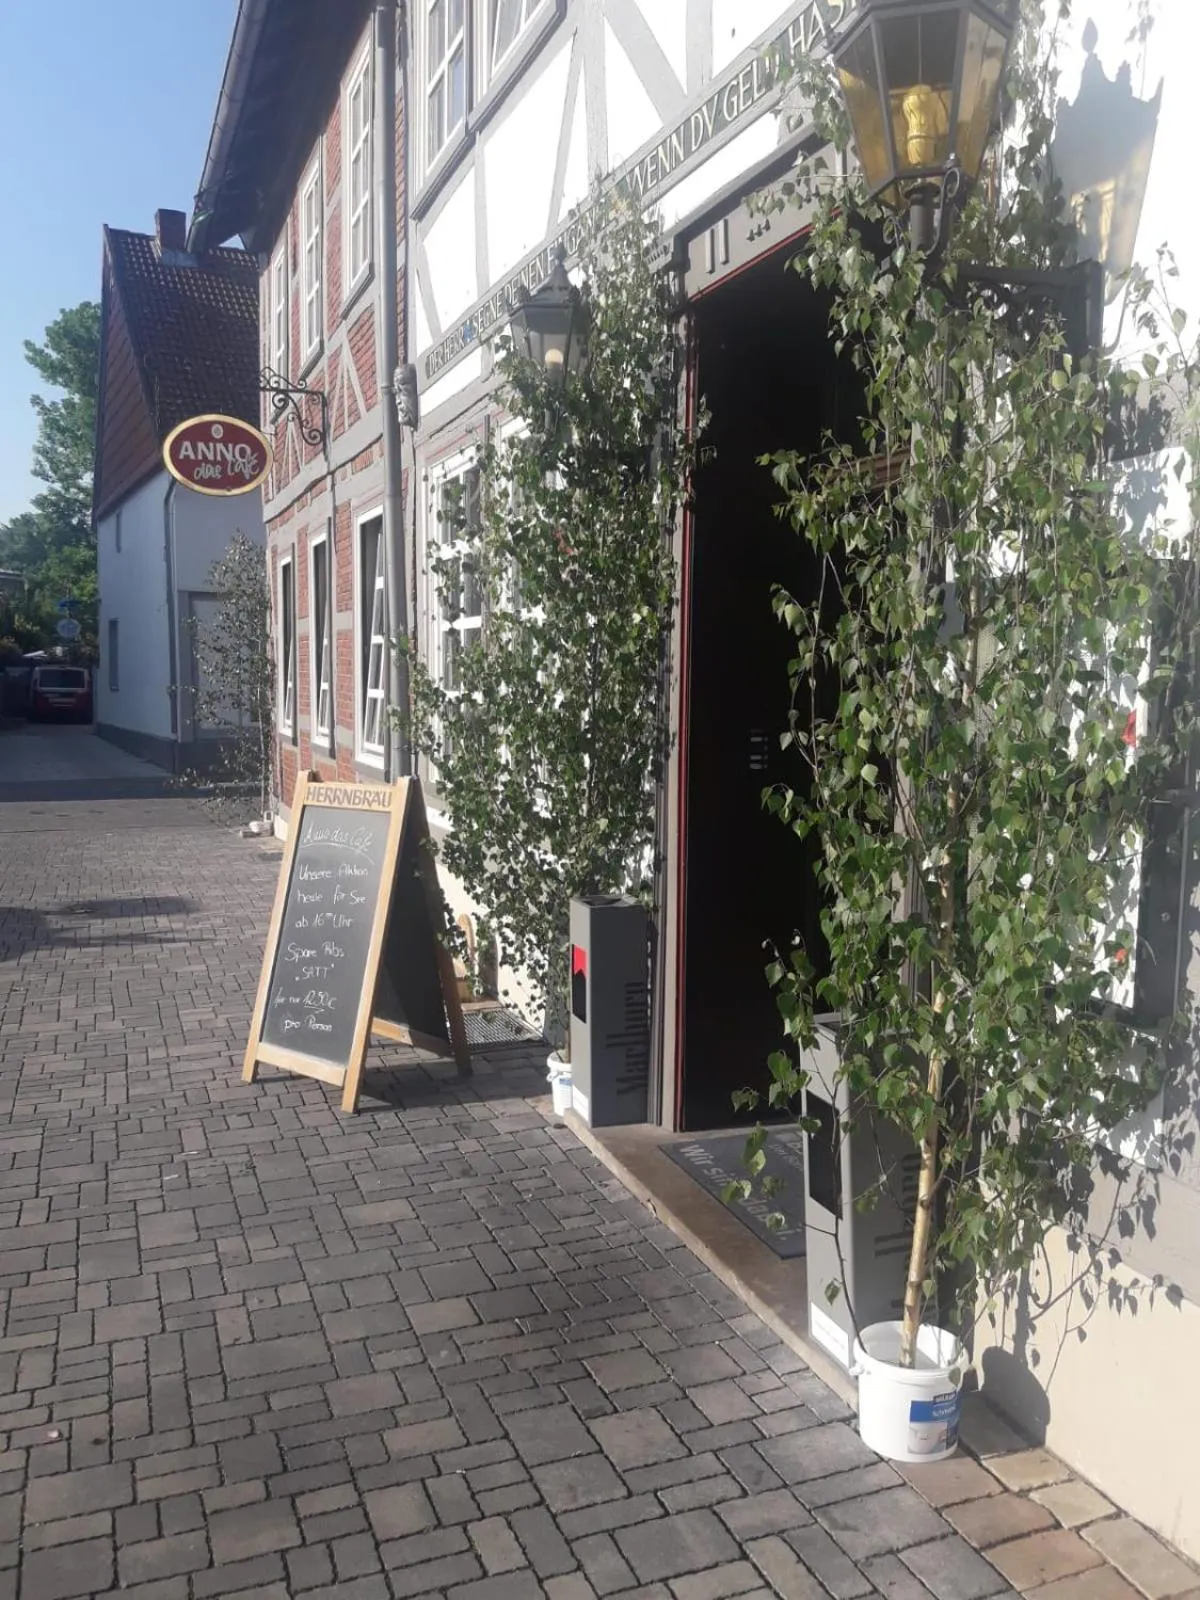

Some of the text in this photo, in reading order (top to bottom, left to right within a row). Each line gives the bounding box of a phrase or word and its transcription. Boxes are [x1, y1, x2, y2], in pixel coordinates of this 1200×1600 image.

[471, 290, 503, 338] SEGNE
[626, 124, 685, 196] WENN
[690, 93, 720, 152] DV
[788, 0, 857, 67] HAS
[179, 441, 251, 461] ANNO
[193, 462, 221, 480] das
[306, 786, 392, 808] HERRNBRÄU
[299, 863, 333, 881] Unsere
[294, 914, 309, 929] ab
[333, 912, 353, 929] Uhr
[679, 1144, 714, 1167] Wir
